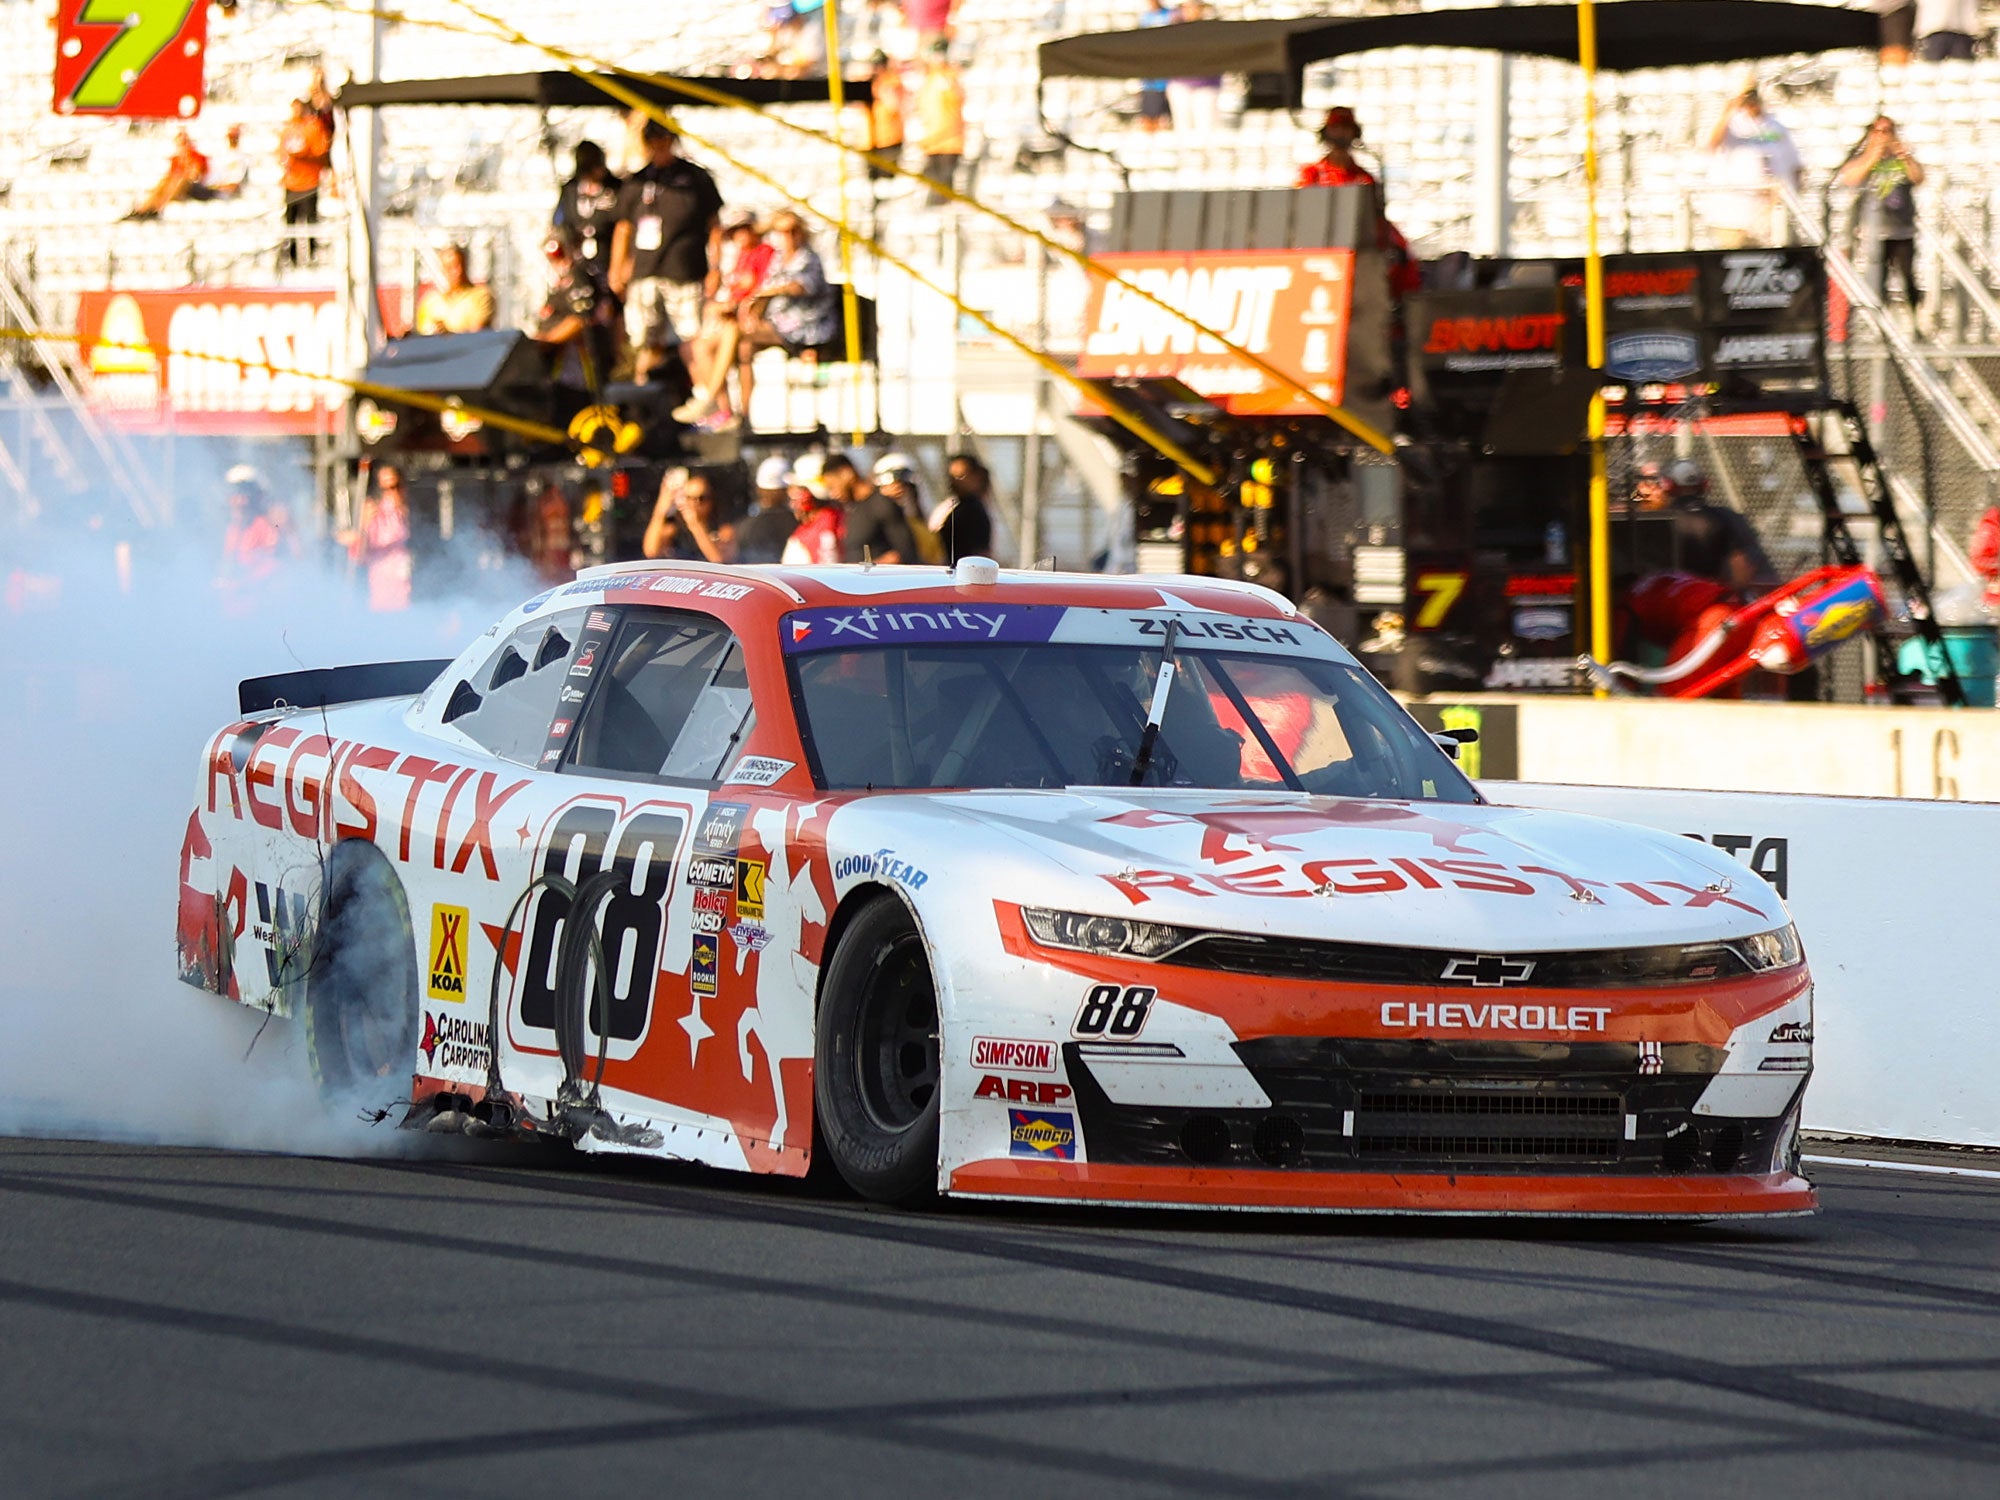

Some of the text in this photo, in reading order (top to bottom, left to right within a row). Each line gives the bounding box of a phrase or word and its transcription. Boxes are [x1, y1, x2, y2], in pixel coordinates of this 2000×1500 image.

[824, 606, 1007, 640] xfinity
[1129, 617, 1301, 646] ZILISCH
[208, 721, 534, 882] REGISTIX
[704, 816, 735, 845] xfinity
[689, 861, 735, 885] COMETIC
[1097, 856, 1767, 917] REGISTIX
[520, 805, 684, 1041] 88
[691, 912, 723, 933] MSD
[431, 973, 463, 993] KOA
[693, 972, 715, 984] ROOKIE
[1076, 985, 1156, 1035] 88
[1380, 1002, 1611, 1032] CHEVROLET
[441, 1042, 492, 1072] CARPORTS
[976, 1041, 1051, 1068] SIMPSON
[973, 1074, 1073, 1104] ARP
[1012, 1126, 1074, 1145] SUNOCO
